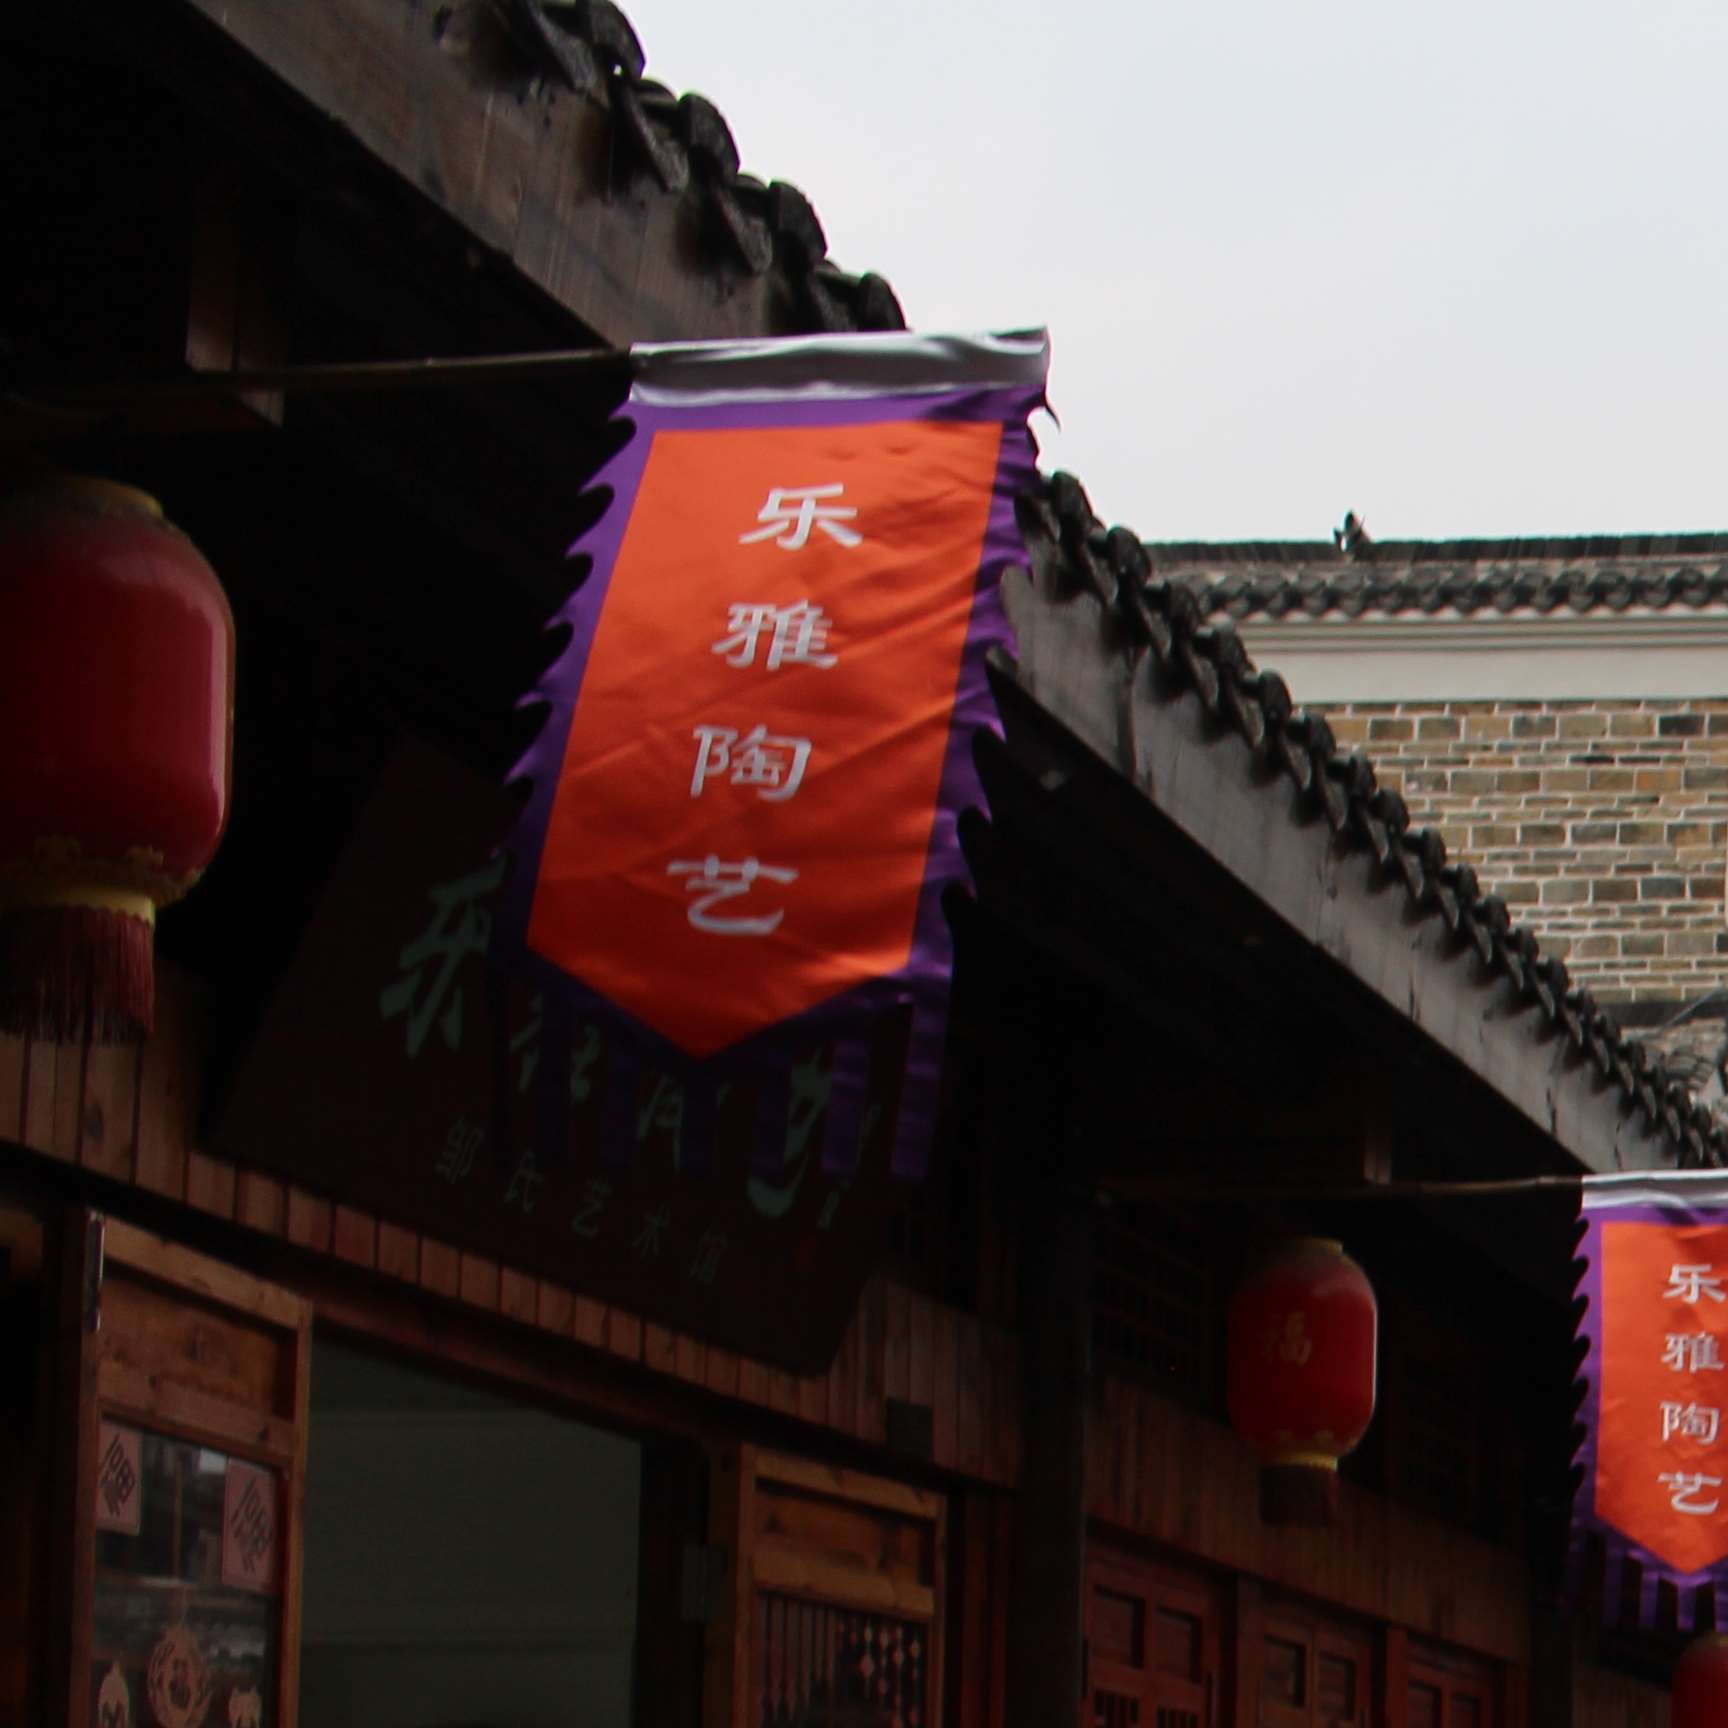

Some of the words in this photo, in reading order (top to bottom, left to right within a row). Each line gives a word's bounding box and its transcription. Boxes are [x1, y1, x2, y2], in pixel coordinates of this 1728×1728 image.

[666, 482, 864, 937] 乐雅陶艺
[1657, 1263, 1727, 1516] 乐雅陶艺
